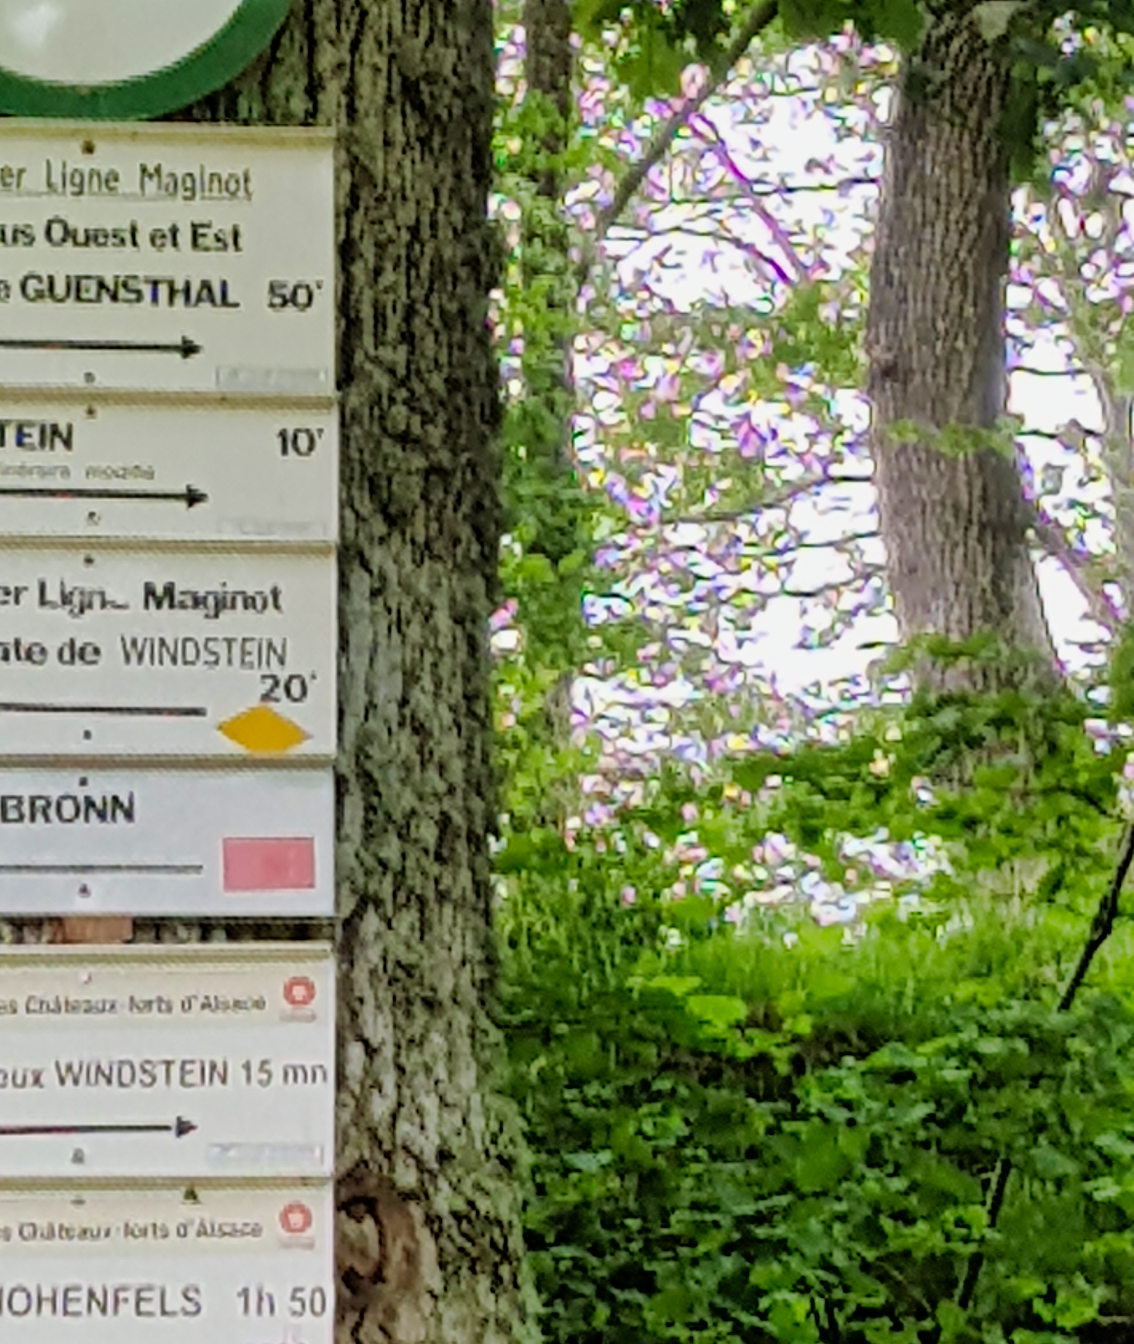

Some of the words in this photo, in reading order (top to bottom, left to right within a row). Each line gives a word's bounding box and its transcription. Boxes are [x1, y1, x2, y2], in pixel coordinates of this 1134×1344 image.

[45, 158, 120, 197] Ligne
[139, 162, 253, 201] Maginot
[44, 217, 139, 252] Ouest
[150, 223, 179, 251] et
[190, 223, 242, 253] Est
[20, 274, 240, 308] GUENSTHAL
[144, 581, 282, 619] Maginot
[58, 636, 101, 666] de
[120, 634, 287, 669] WINDSTEIN
[56, 1059, 230, 1089] WINDSTEIN
[241, 1059, 273, 1088] 15
[284, 1063, 328, 1087] mn
[237, 1286, 275, 1318] 1h
[289, 1286, 327, 1318] 50
